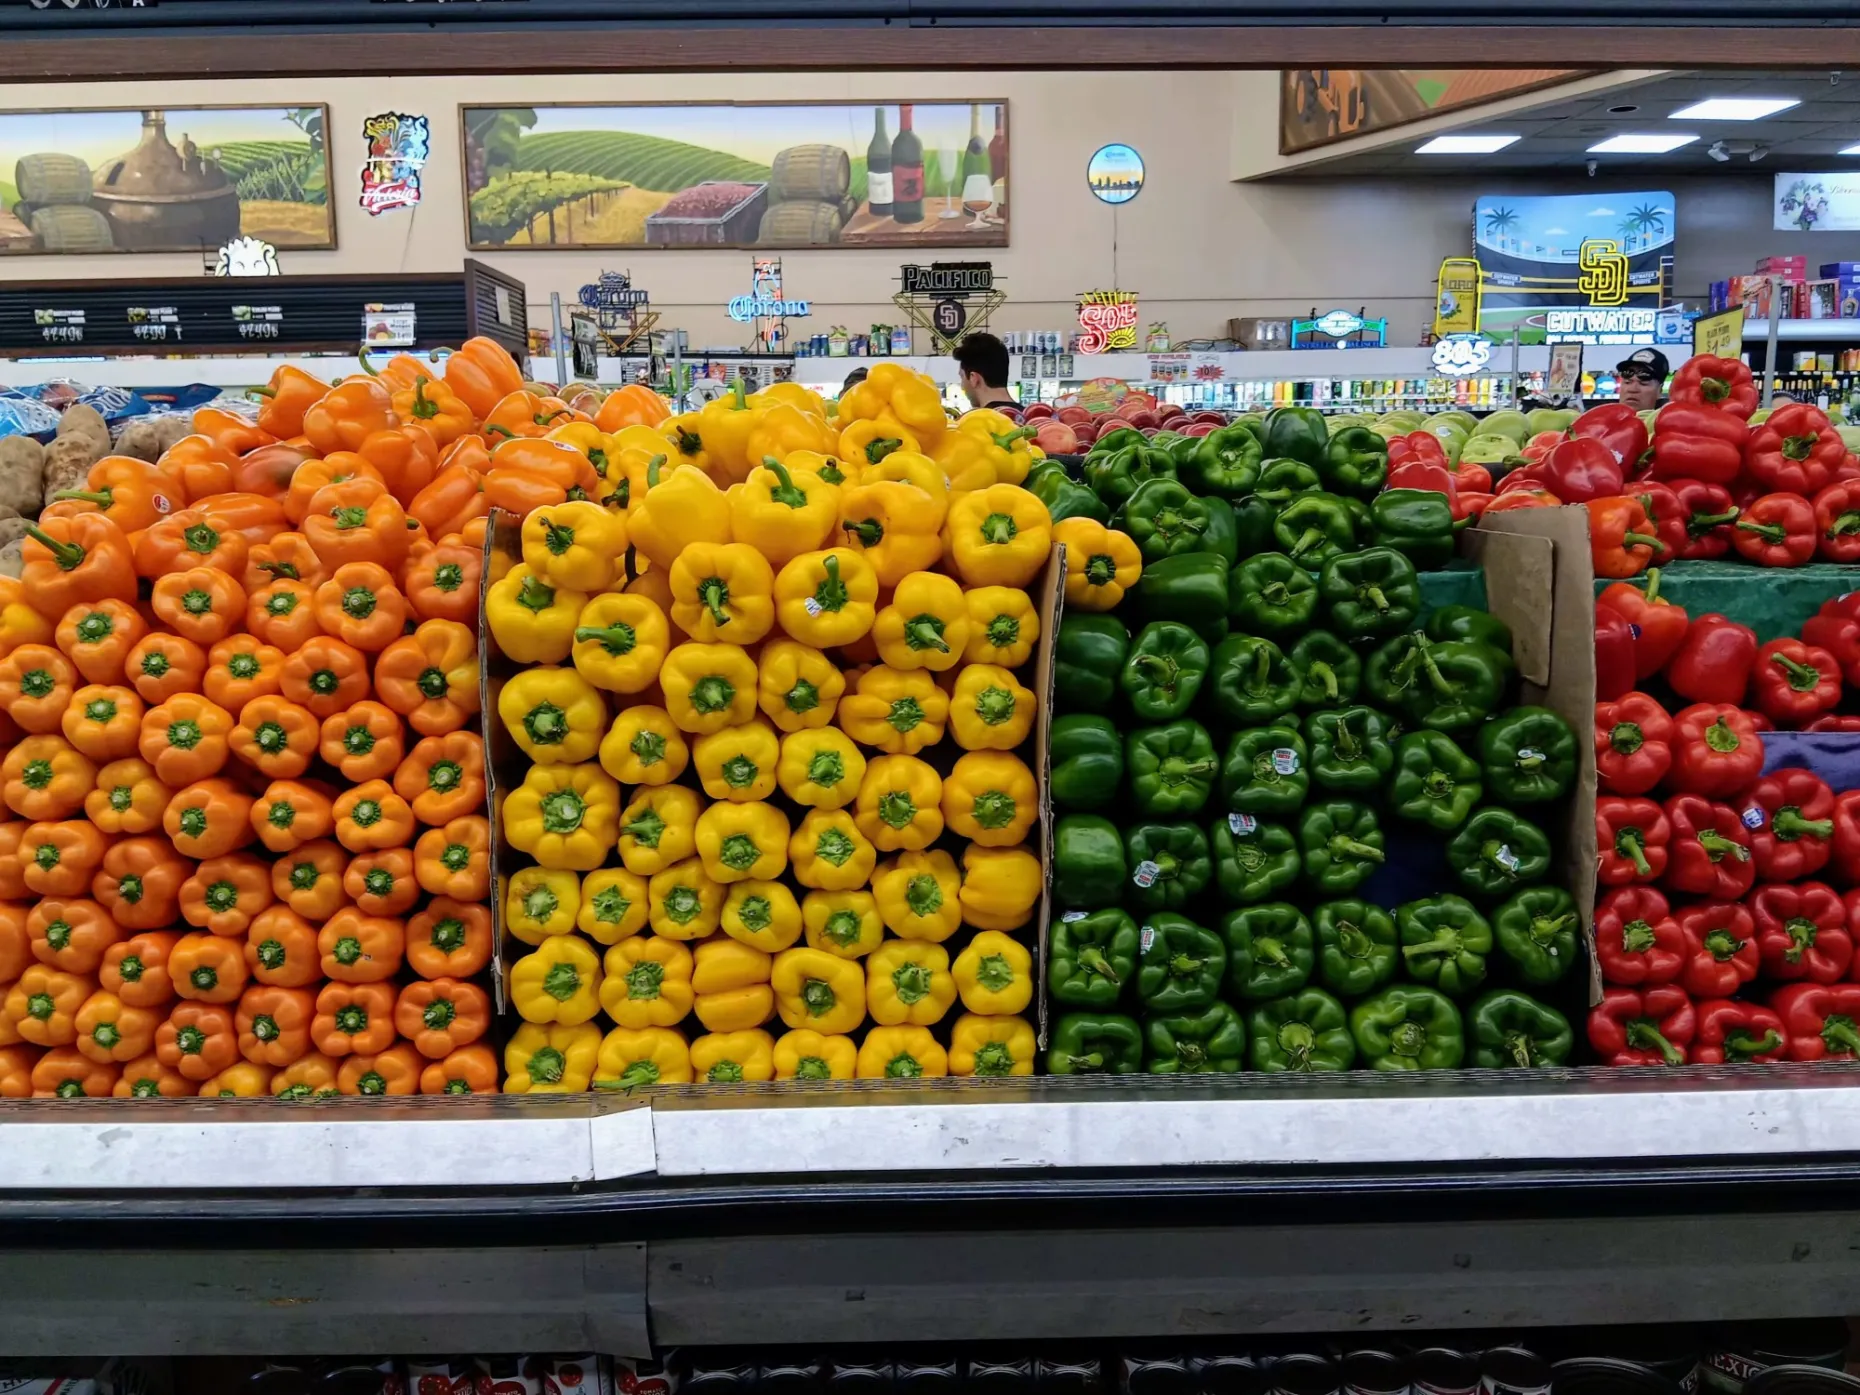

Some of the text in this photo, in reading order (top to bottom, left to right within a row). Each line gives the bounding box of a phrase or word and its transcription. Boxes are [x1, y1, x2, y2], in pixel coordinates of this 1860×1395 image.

[902, 265, 993, 293] PACIFICO
[578, 284, 649, 309] Corona
[728, 296, 808, 323] Corona
[940, 304, 958, 329] SD
[1547, 311, 1656, 333] CUTWATER
[1432, 340, 1490, 366] 805
